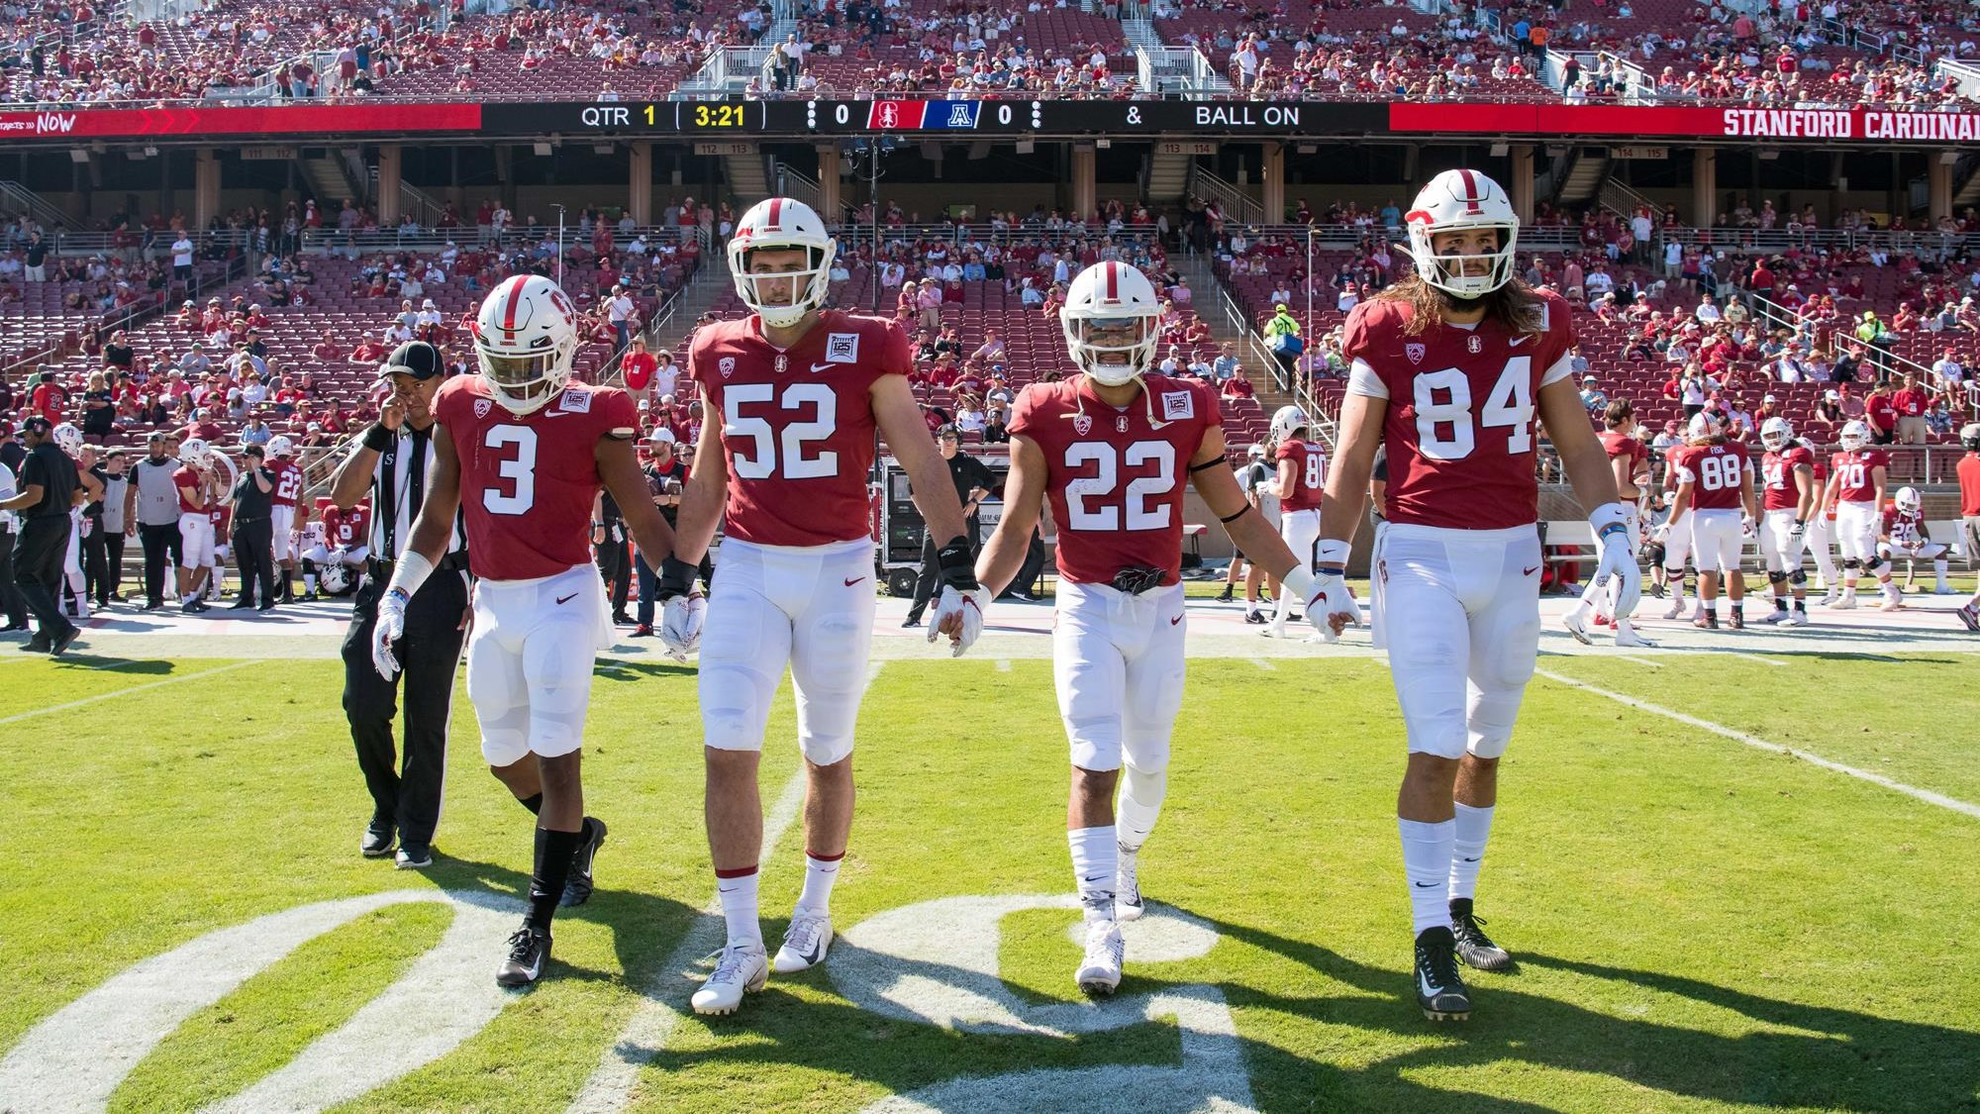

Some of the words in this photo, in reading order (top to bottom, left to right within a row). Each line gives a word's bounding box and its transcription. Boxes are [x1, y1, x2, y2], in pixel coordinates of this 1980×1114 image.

[36, 112, 76, 134] NOW
[582, 106, 630, 128] QTR
[644, 106, 655, 126] 1
[695, 105, 745, 127] 3:21
[835, 104, 849, 124] 0
[998, 105, 1012, 124] 0
[1127, 106, 1142, 124] &
[1197, 106, 1256, 125] BALL
[1264, 106, 1299, 125] ON
[1724, 109, 1851, 138] STANFORD
[248, 148, 263, 158] 111
[276, 148, 292, 158] 112
[702, 144, 718, 154] 112
[731, 144, 748, 154] 113
[1164, 143, 1181, 154] 113
[1194, 143, 1210, 154] 114
[1617, 148, 1633, 158] 114
[1647, 148, 1662, 158] 115
[1413, 355, 1536, 460] 84
[722, 382, 839, 480] 52
[384, 453, 395, 465] S
[482, 423, 539, 516] 3
[1700, 454, 1742, 491] 88
[1837, 464, 1866, 490] 70
[277, 471, 303, 500] 22
[1064, 440, 1176, 532] 22
